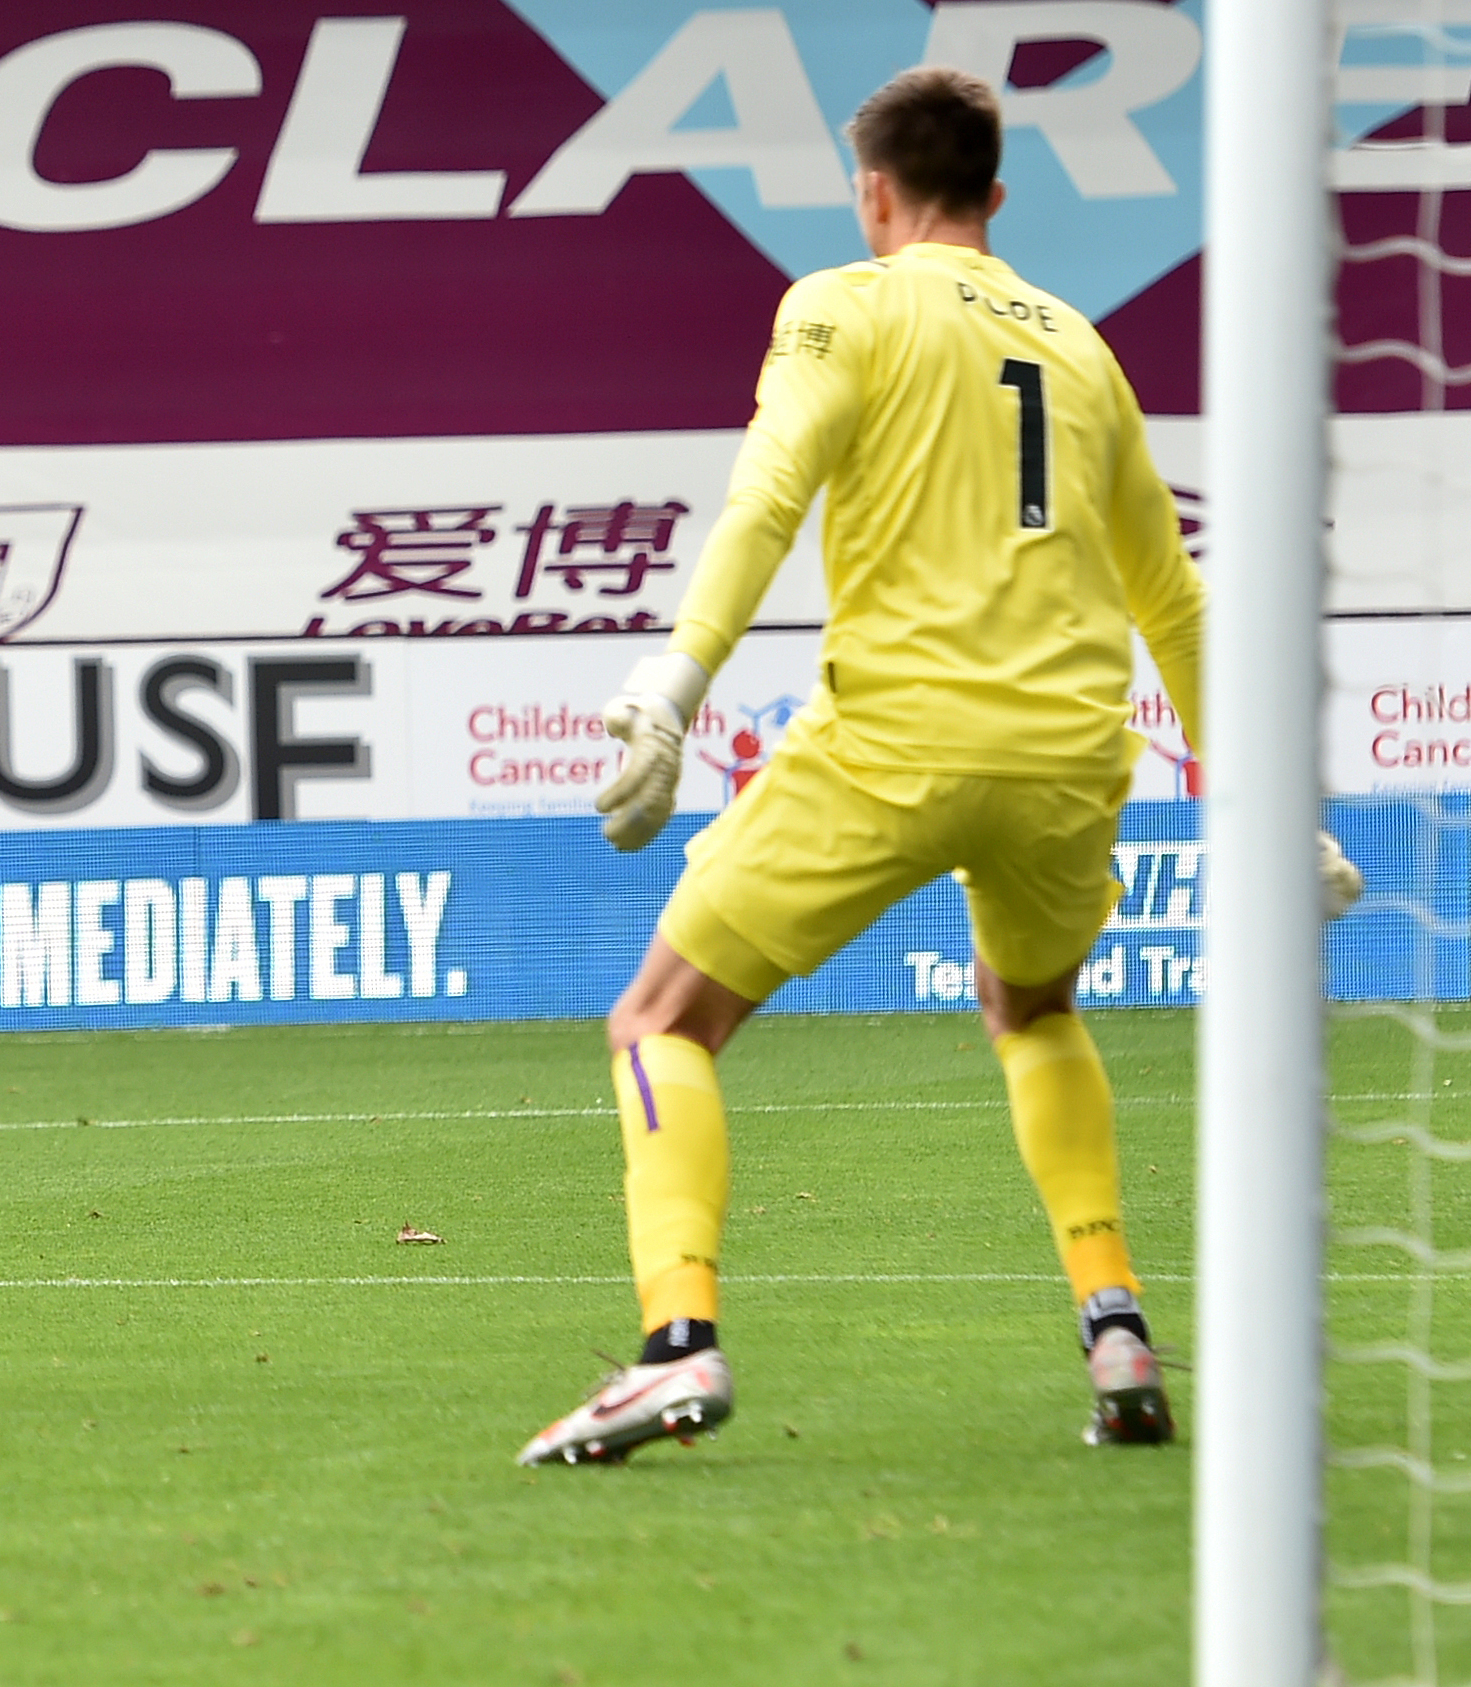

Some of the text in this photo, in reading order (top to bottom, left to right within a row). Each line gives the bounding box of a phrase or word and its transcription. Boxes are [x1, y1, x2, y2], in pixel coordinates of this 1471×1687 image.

[999, 357, 1050, 531] 1
[321, 501, 689, 600] 爱博
[467, 701, 605, 743] Childre
[1131, 690, 1176, 727] ith
[469, 747, 606, 786] Cancer
